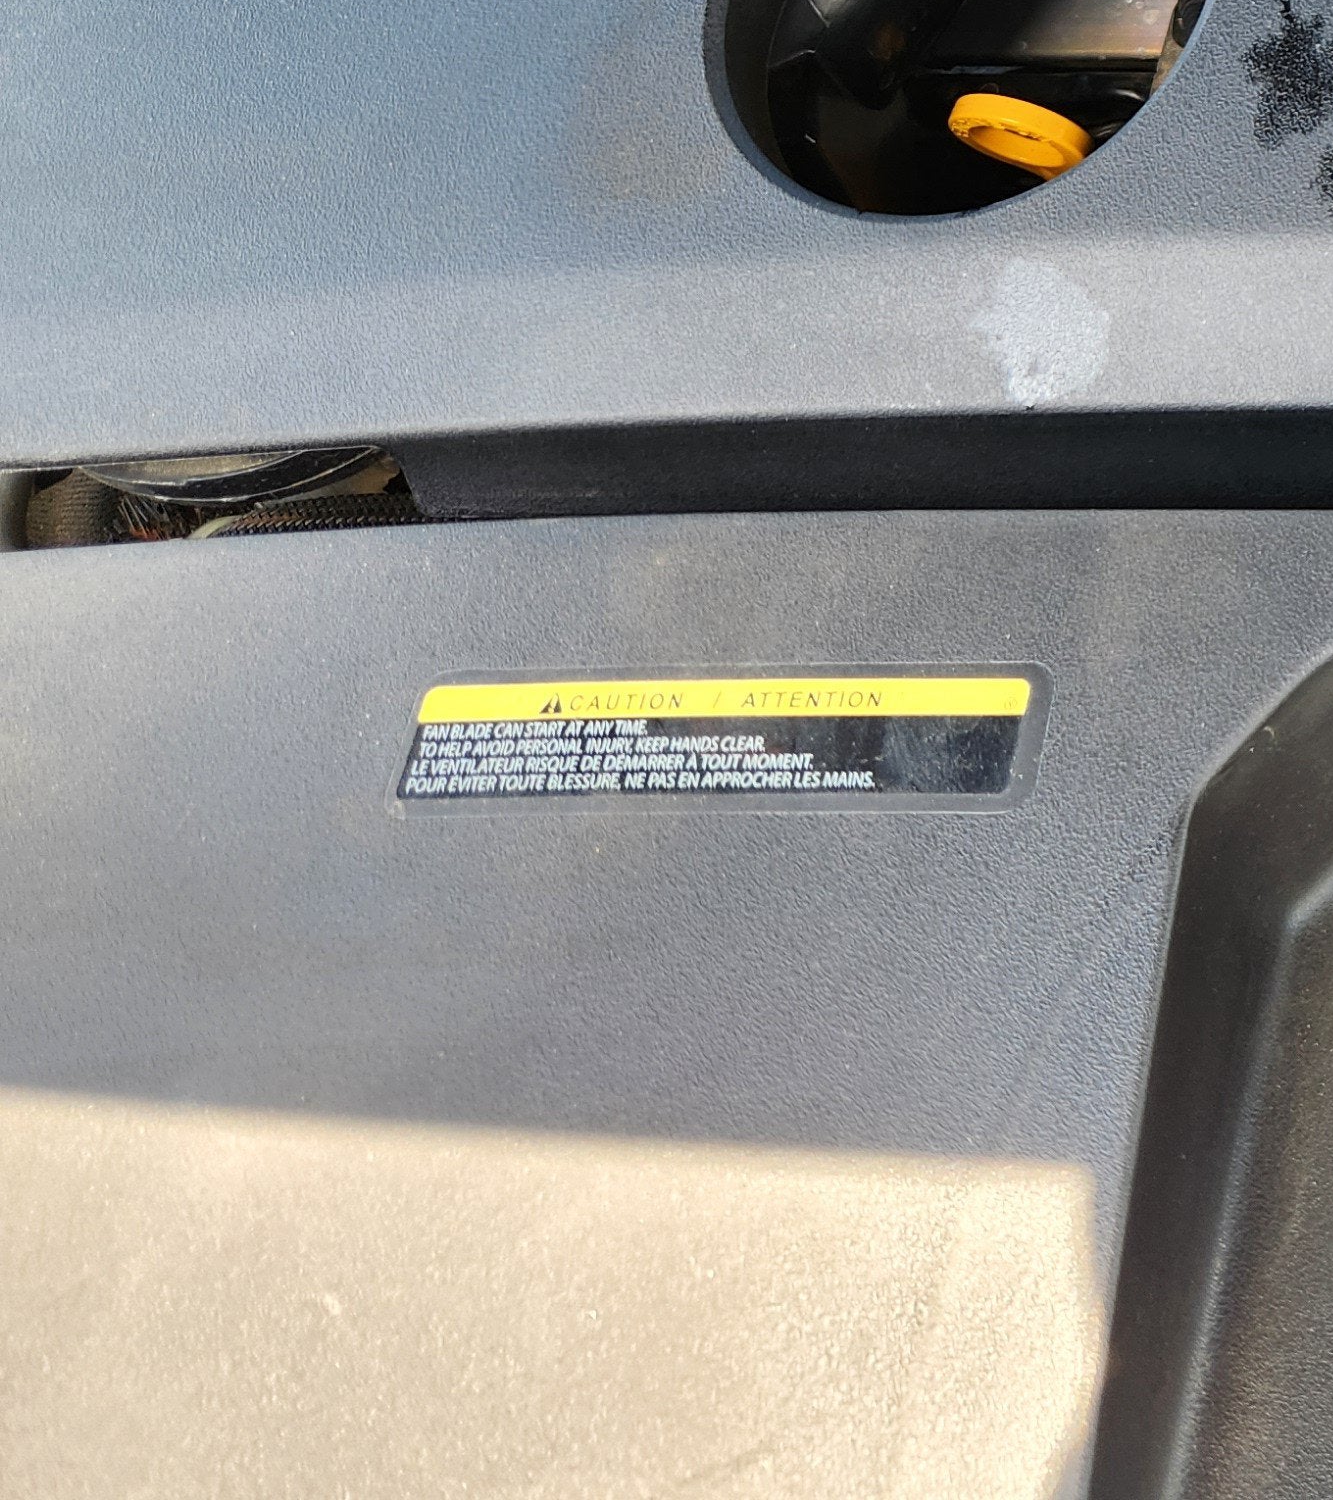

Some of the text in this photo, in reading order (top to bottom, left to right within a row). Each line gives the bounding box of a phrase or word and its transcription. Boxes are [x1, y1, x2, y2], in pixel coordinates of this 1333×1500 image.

[569, 692, 684, 712] CAUTION
[740, 690, 883, 708] ATTENTION
[422, 719, 648, 740] FAN BLADE CAN START AT ANY TIME.
[420, 741, 438, 758] TO
[438, 740, 476, 757] HELP
[475, 739, 516, 757] AVOID
[516, 738, 583, 756] PERSONAL
[635, 736, 669, 753] KEEP
[670, 736, 720, 752] HANDS
[720, 735, 766, 752] CLEAR.
[411, 760, 430, 776] LE
[430, 757, 525, 775] VENTILATEUR
[525, 755, 580, 774] RISQUE
[580, 755, 603, 772] DE
[700, 753, 742, 771] TOUT
[742, 753, 814, 771] MOMENT.
[405, 776, 448, 795] POUR
[499, 774, 546, 792] TOUTE
[624, 772, 646, 789] NE
[647, 771, 676, 789] PAS
[677, 771, 701, 789] EN
[701, 771, 793, 789] APPROCHER
[793, 771, 822, 789] LES
[822, 771, 876, 789] MAINS.
